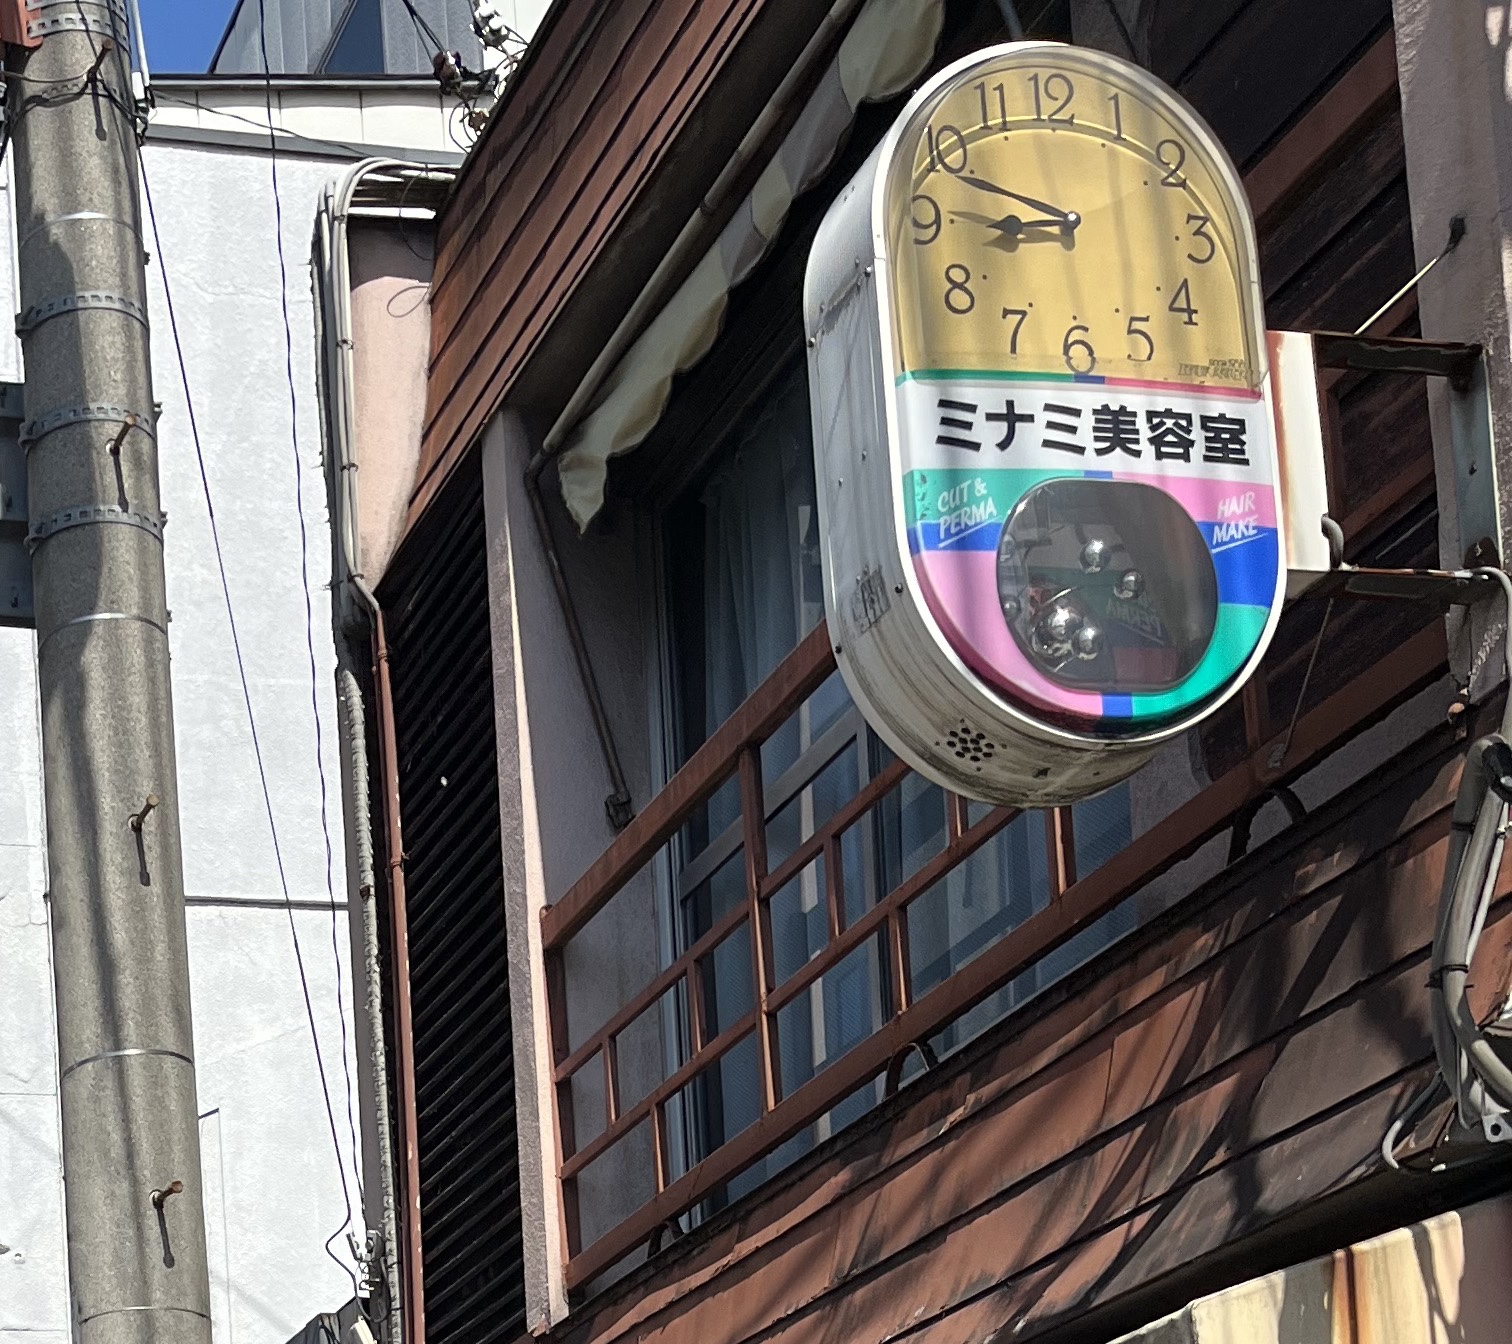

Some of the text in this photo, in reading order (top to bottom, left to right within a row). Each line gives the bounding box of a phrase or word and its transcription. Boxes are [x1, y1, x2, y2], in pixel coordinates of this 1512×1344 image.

[973, 81, 1012, 132] 11
[1027, 73, 1075, 127] 12
[1107, 92, 1127, 141] 1
[925, 124, 968, 174] 10
[1155, 138, 1187, 190] 2
[911, 194, 942, 245] 9
[1186, 213, 1216, 264] 3
[944, 263, 975, 315] 8
[1168, 278, 1199, 326] 4
[1001, 307, 1028, 355] 7
[1062, 324, 1096, 374] 6
[1126, 315, 1154, 362] 5
[935, 399, 1251, 467] ミナミ美容室
[937, 477, 988, 513] CUT &
[939, 496, 997, 540] PERMA
[1217, 490, 1256, 520] HAIR
[1212, 513, 1259, 546] MAKE
